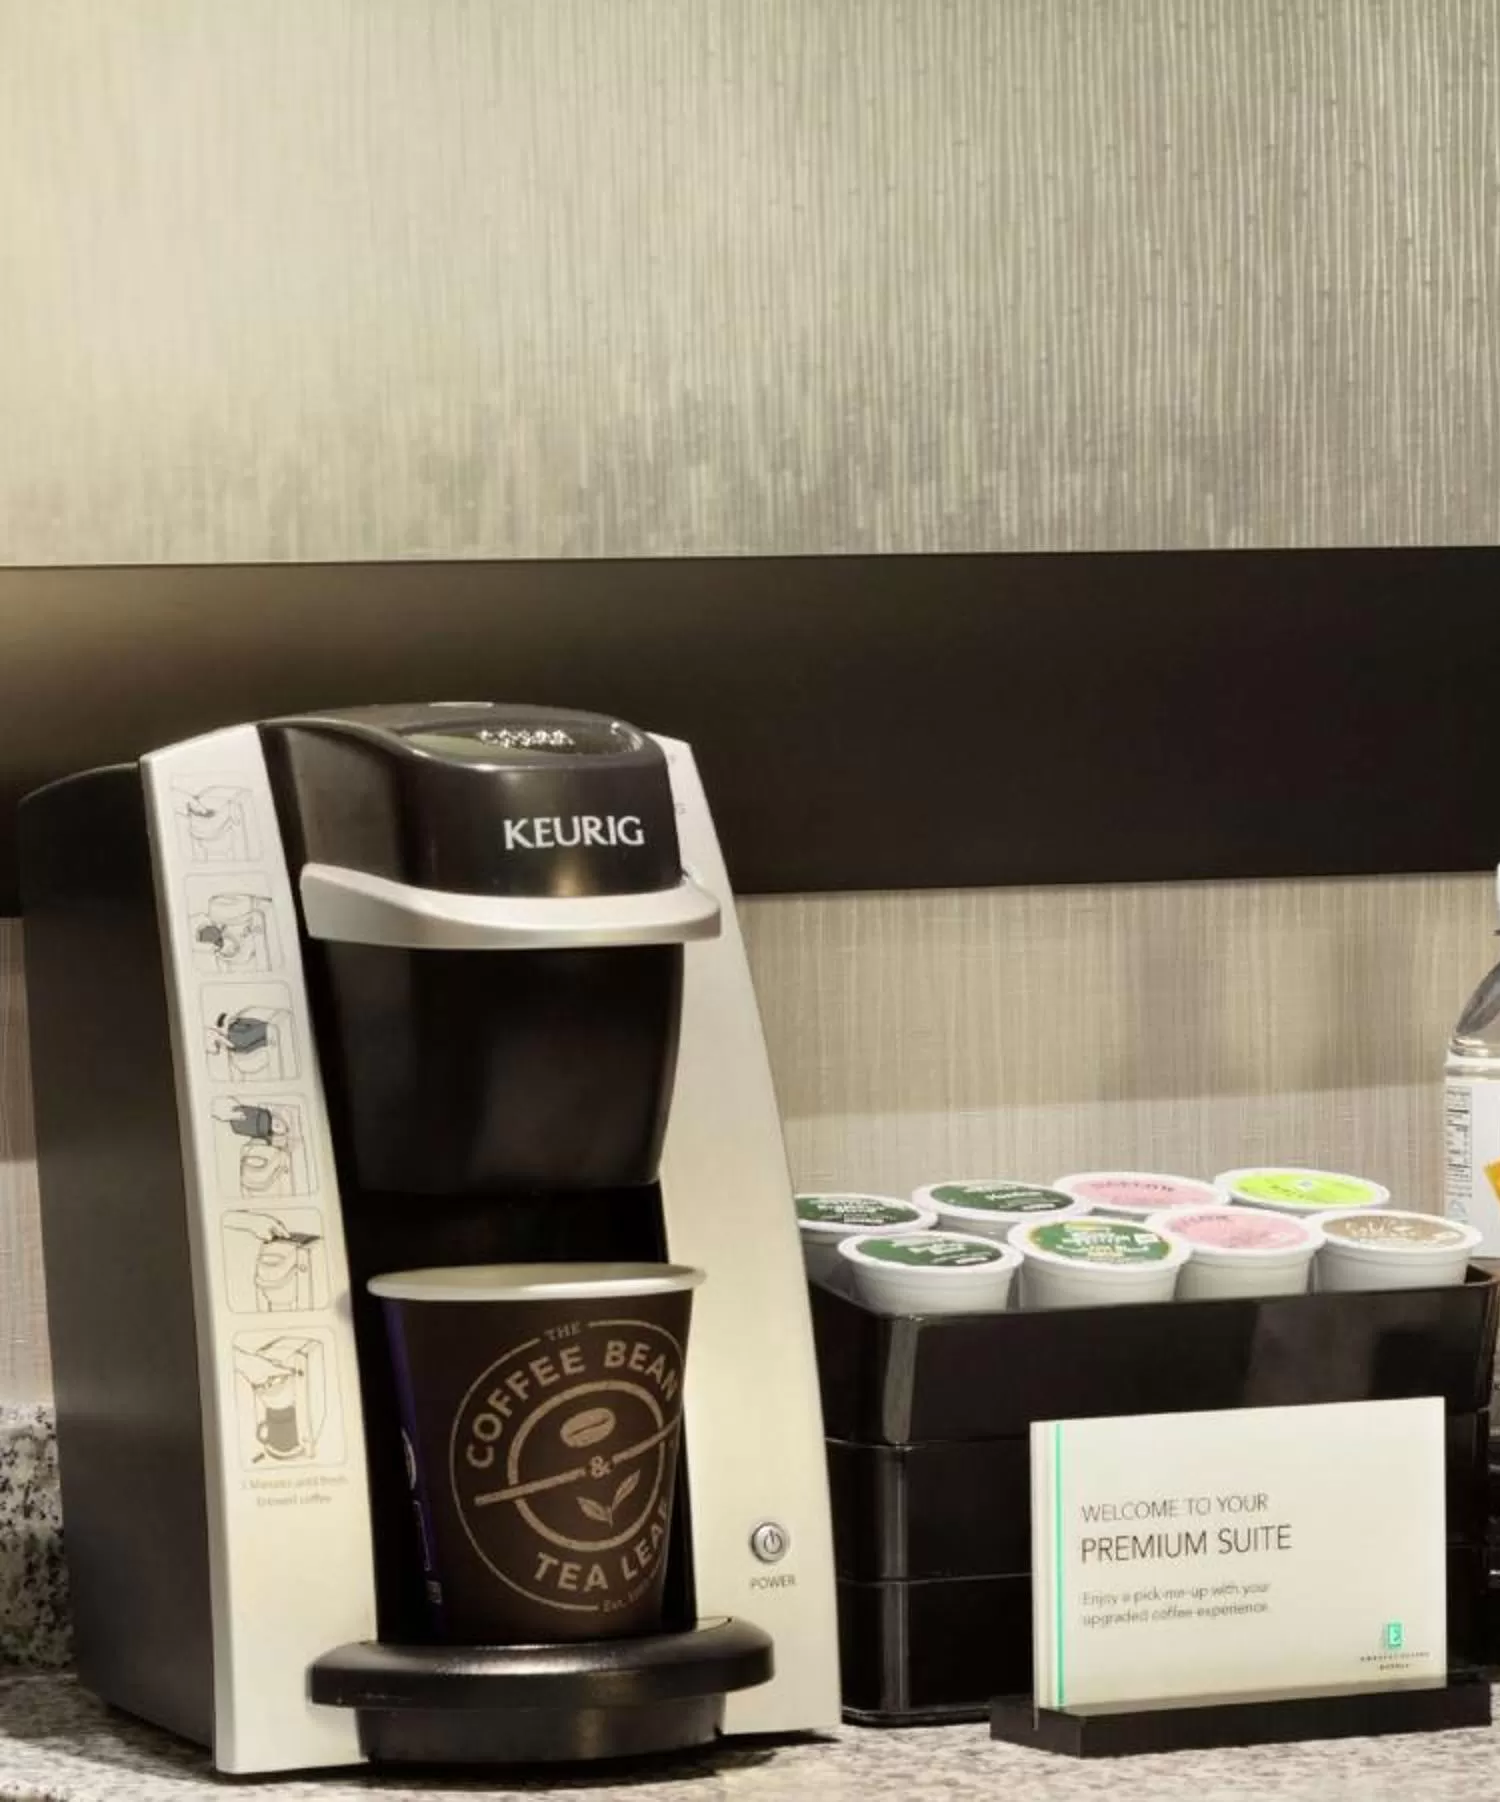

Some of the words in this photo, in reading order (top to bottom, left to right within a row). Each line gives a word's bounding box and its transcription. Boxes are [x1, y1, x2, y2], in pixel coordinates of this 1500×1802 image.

[503, 815, 645, 850] KEURIG
[544, 1321, 582, 1341] THE
[466, 1345, 587, 1469] COFFEE
[603, 1339, 679, 1401] BEAN
[588, 1456, 613, 1478] &
[1081, 1499, 1179, 1522] WELCOME
[1187, 1497, 1212, 1517] TO
[1216, 1493, 1269, 1513] YOUR
[1081, 1530, 1207, 1563] PREMIUM
[1217, 1524, 1293, 1555] SUITE
[533, 1552, 609, 1592] TEA
[750, 1575, 796, 1590] POWER
[1083, 1590, 1118, 1608] Enjoy
[1212, 1582, 1239, 1596] with
[1241, 1582, 1271, 1597] your
[1083, 1607, 1149, 1629] upgraded
[1151, 1604, 1194, 1621] coffee
